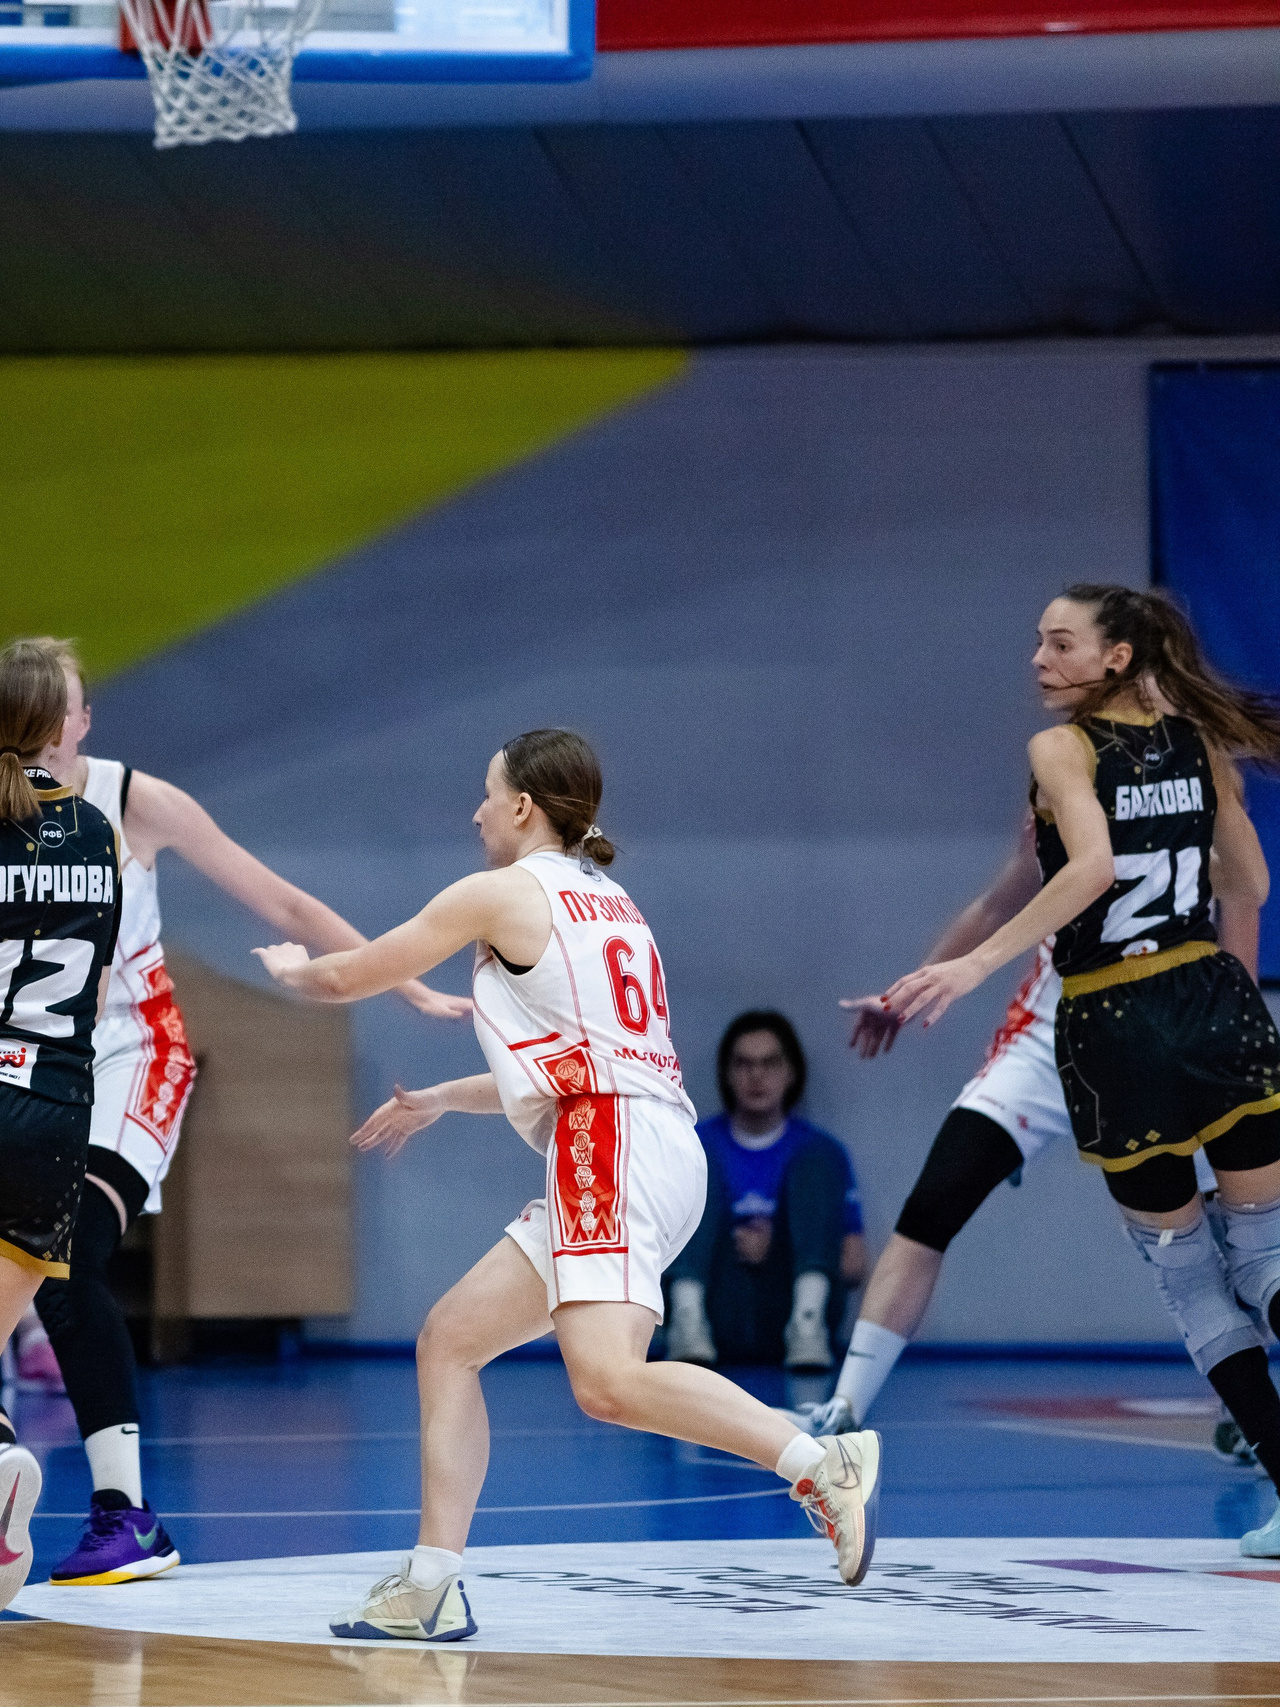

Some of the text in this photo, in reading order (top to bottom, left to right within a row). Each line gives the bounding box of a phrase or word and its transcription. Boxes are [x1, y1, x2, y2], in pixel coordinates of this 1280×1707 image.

[42, 830, 63, 838] РФБ
[1100, 846, 1203, 944] 21
[602, 935, 672, 1041] 64
[477, 1571, 824, 1614] СПОРТА
[639, 1566, 1205, 1634] ПОДДЕРЖКИ
